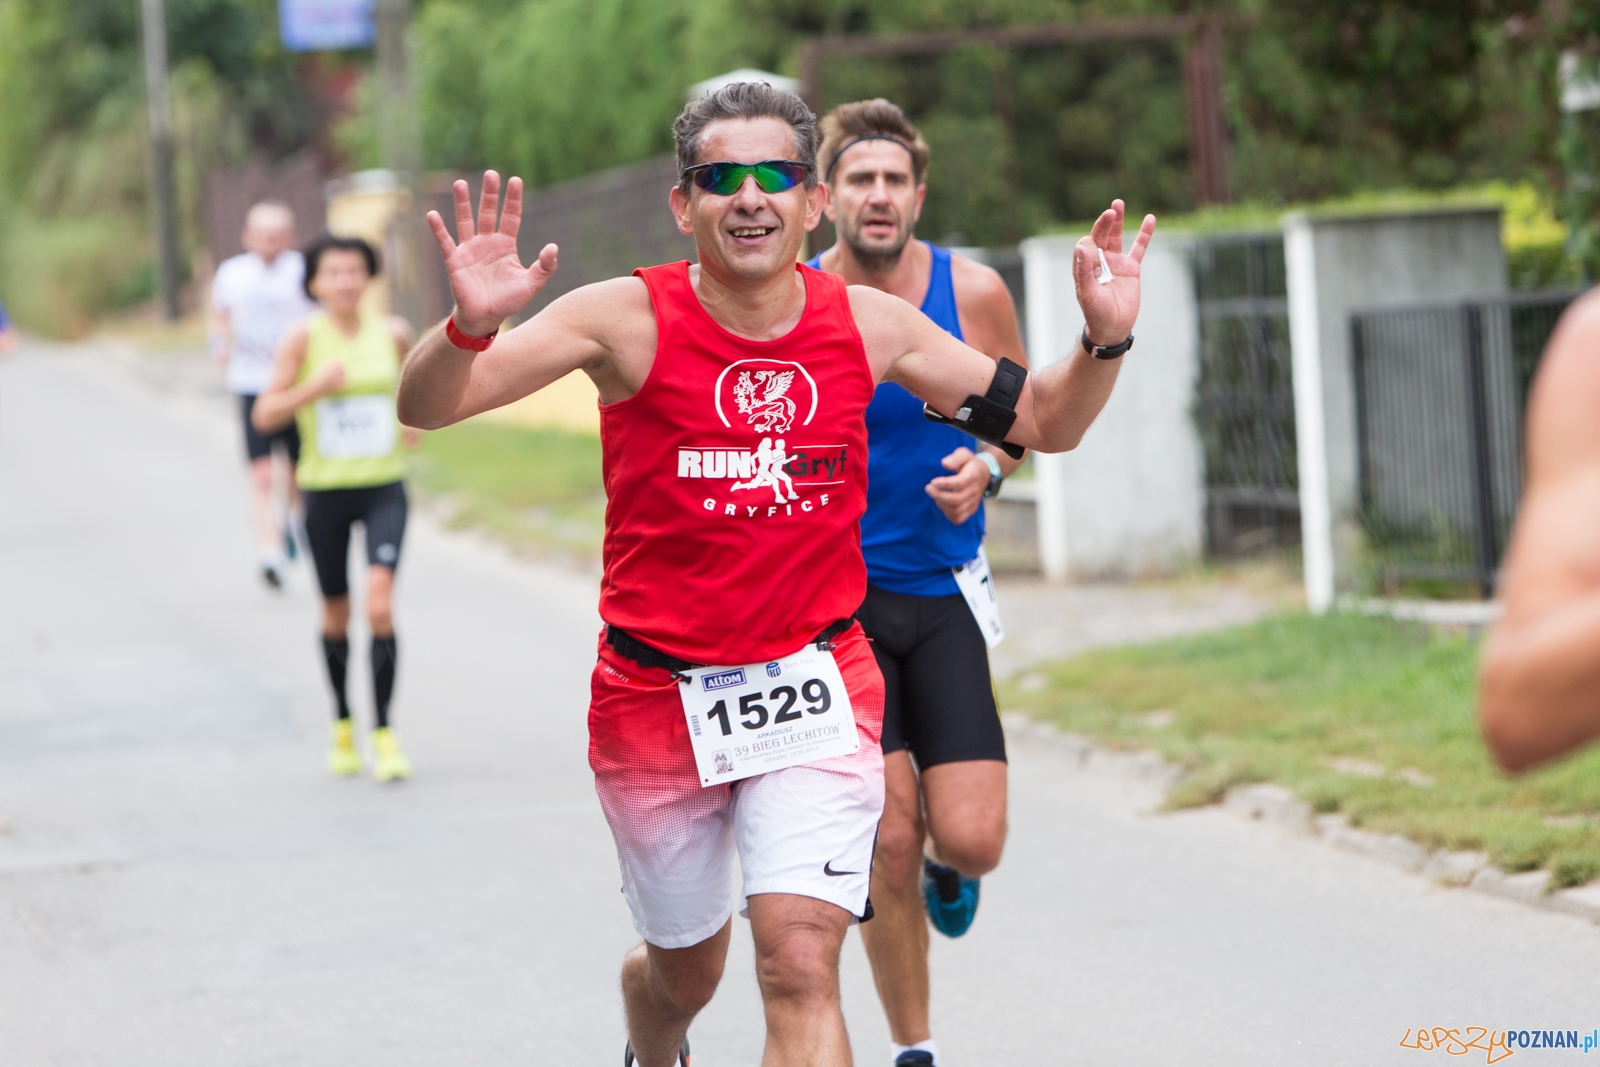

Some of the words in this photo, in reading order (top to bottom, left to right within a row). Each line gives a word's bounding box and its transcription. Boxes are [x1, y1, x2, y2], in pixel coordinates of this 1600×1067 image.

[677, 450, 751, 478] RUN
[784, 449, 849, 480] Gryf
[703, 494, 829, 517] GRYFICE
[605, 666, 629, 683] DRI-FIT
[706, 678, 832, 736] 1529
[734, 745, 749, 757] 39
[752, 738, 781, 753] BIEG
[783, 723, 840, 745] LECHITÓW
[757, 726, 793, 739] ARKADIUSZ
